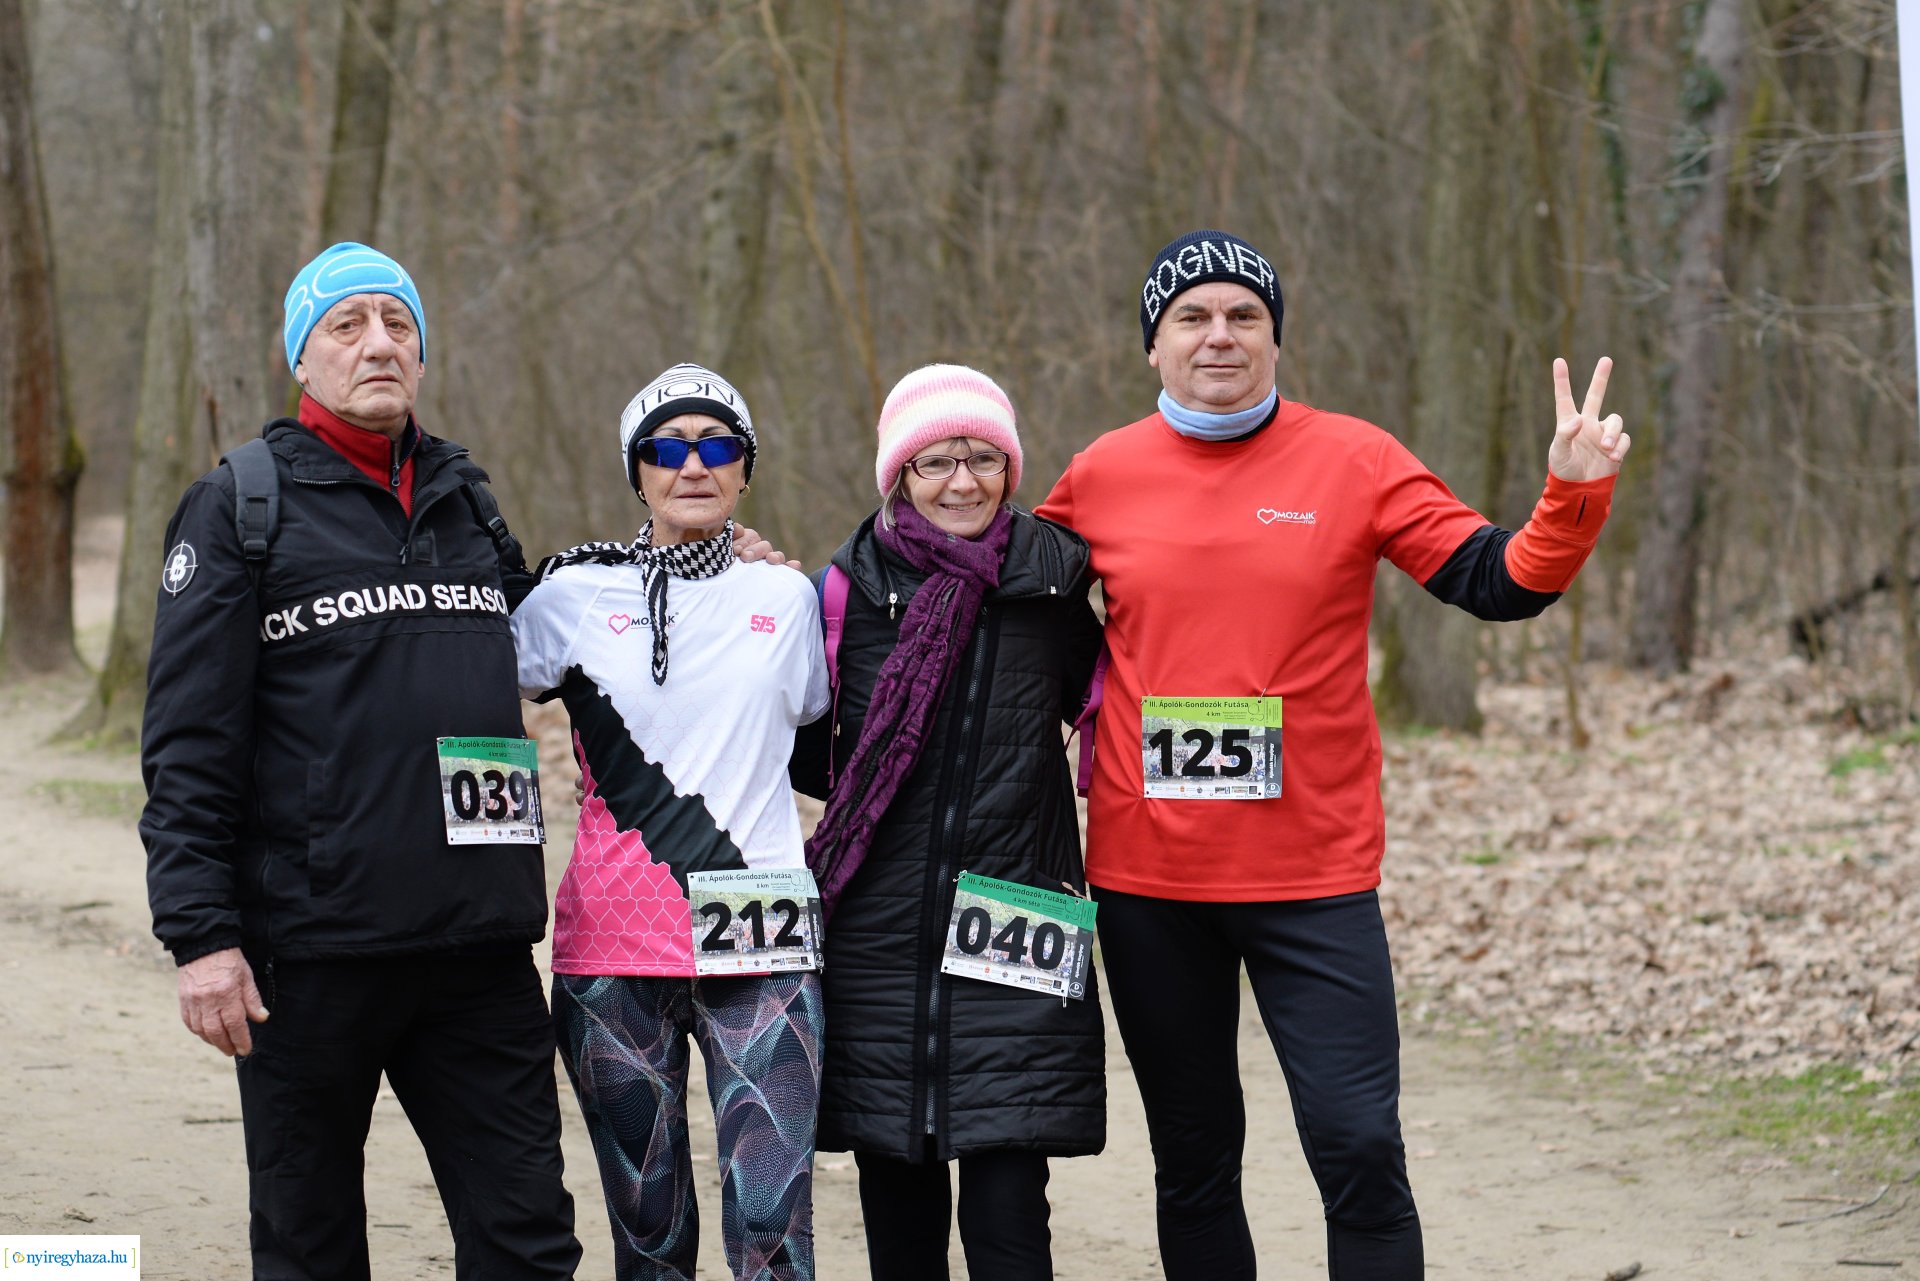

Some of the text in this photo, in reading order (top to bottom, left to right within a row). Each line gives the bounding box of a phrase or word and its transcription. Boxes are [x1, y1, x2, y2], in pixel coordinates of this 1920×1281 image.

[1143, 240, 1275, 323] BOGNER
[1277, 511, 1314, 520] MOZAIK
[313, 584, 427, 626] SQUAD
[431, 584, 509, 616] SEASO
[750, 614, 776, 634] 575
[1159, 700, 1222, 709] Ápolók-Gondozók
[1148, 729, 1253, 777] 125
[451, 770, 529, 820] 039
[709, 873, 770, 883] Ápolók-Gondozók
[771, 872, 792, 880] Futása
[979, 879, 1043, 899] Ápolók-Gondozók
[1043, 893, 1067, 905] Futása
[1028, 899, 1041, 908] séta
[699, 899, 803, 951] 212
[956, 906, 1065, 970] 040
